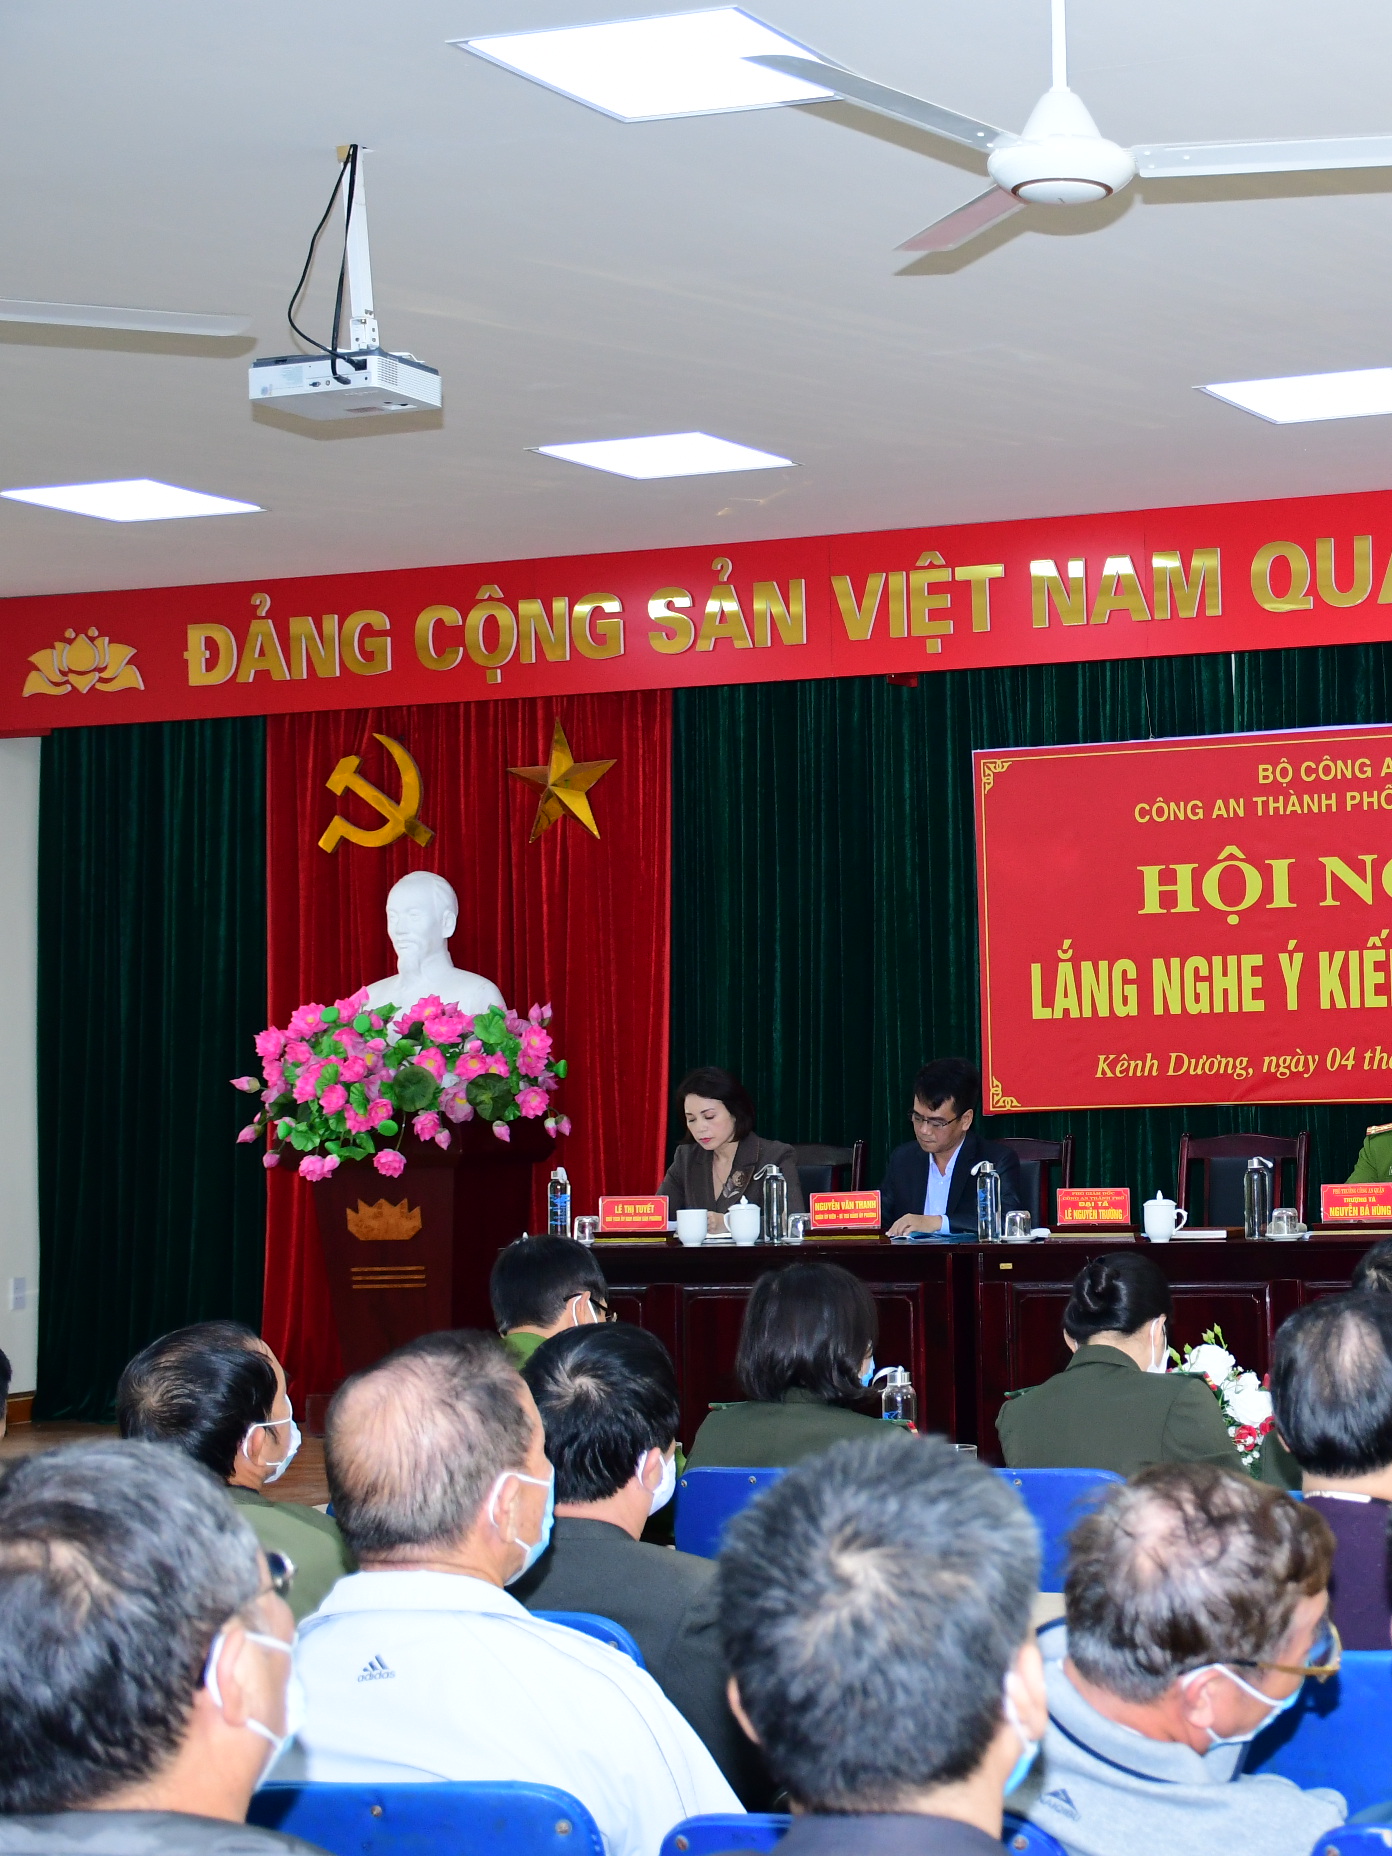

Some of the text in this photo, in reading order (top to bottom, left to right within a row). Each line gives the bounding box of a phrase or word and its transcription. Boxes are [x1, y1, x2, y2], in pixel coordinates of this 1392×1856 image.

[184, 590, 392, 686] ĐẢNG
[414, 584, 624, 684] CỘNG
[648, 556, 807, 654] SẢN
[832, 551, 1005, 654] VIỆT
[1029, 547, 1222, 629] NAM
[1259, 758, 1292, 786] BỘ
[1301, 756, 1371, 781] CÔNG
[1135, 797, 1203, 822] CÔNG
[1212, 798, 1244, 818] AN
[1253, 784, 1336, 816] THÀNH
[1137, 845, 1296, 924] HỘI
[1031, 939, 1137, 1019] LẮNG
[1153, 954, 1264, 1015] NGHE
[1279, 940, 1303, 1010] Ý
[1095, 1053, 1158, 1077] Kênh
[1167, 1053, 1253, 1079] Dương,
[1263, 1049, 1318, 1078] ngày
[1326, 1047, 1356, 1071] 04
[358, 1671, 395, 1682] adidas
